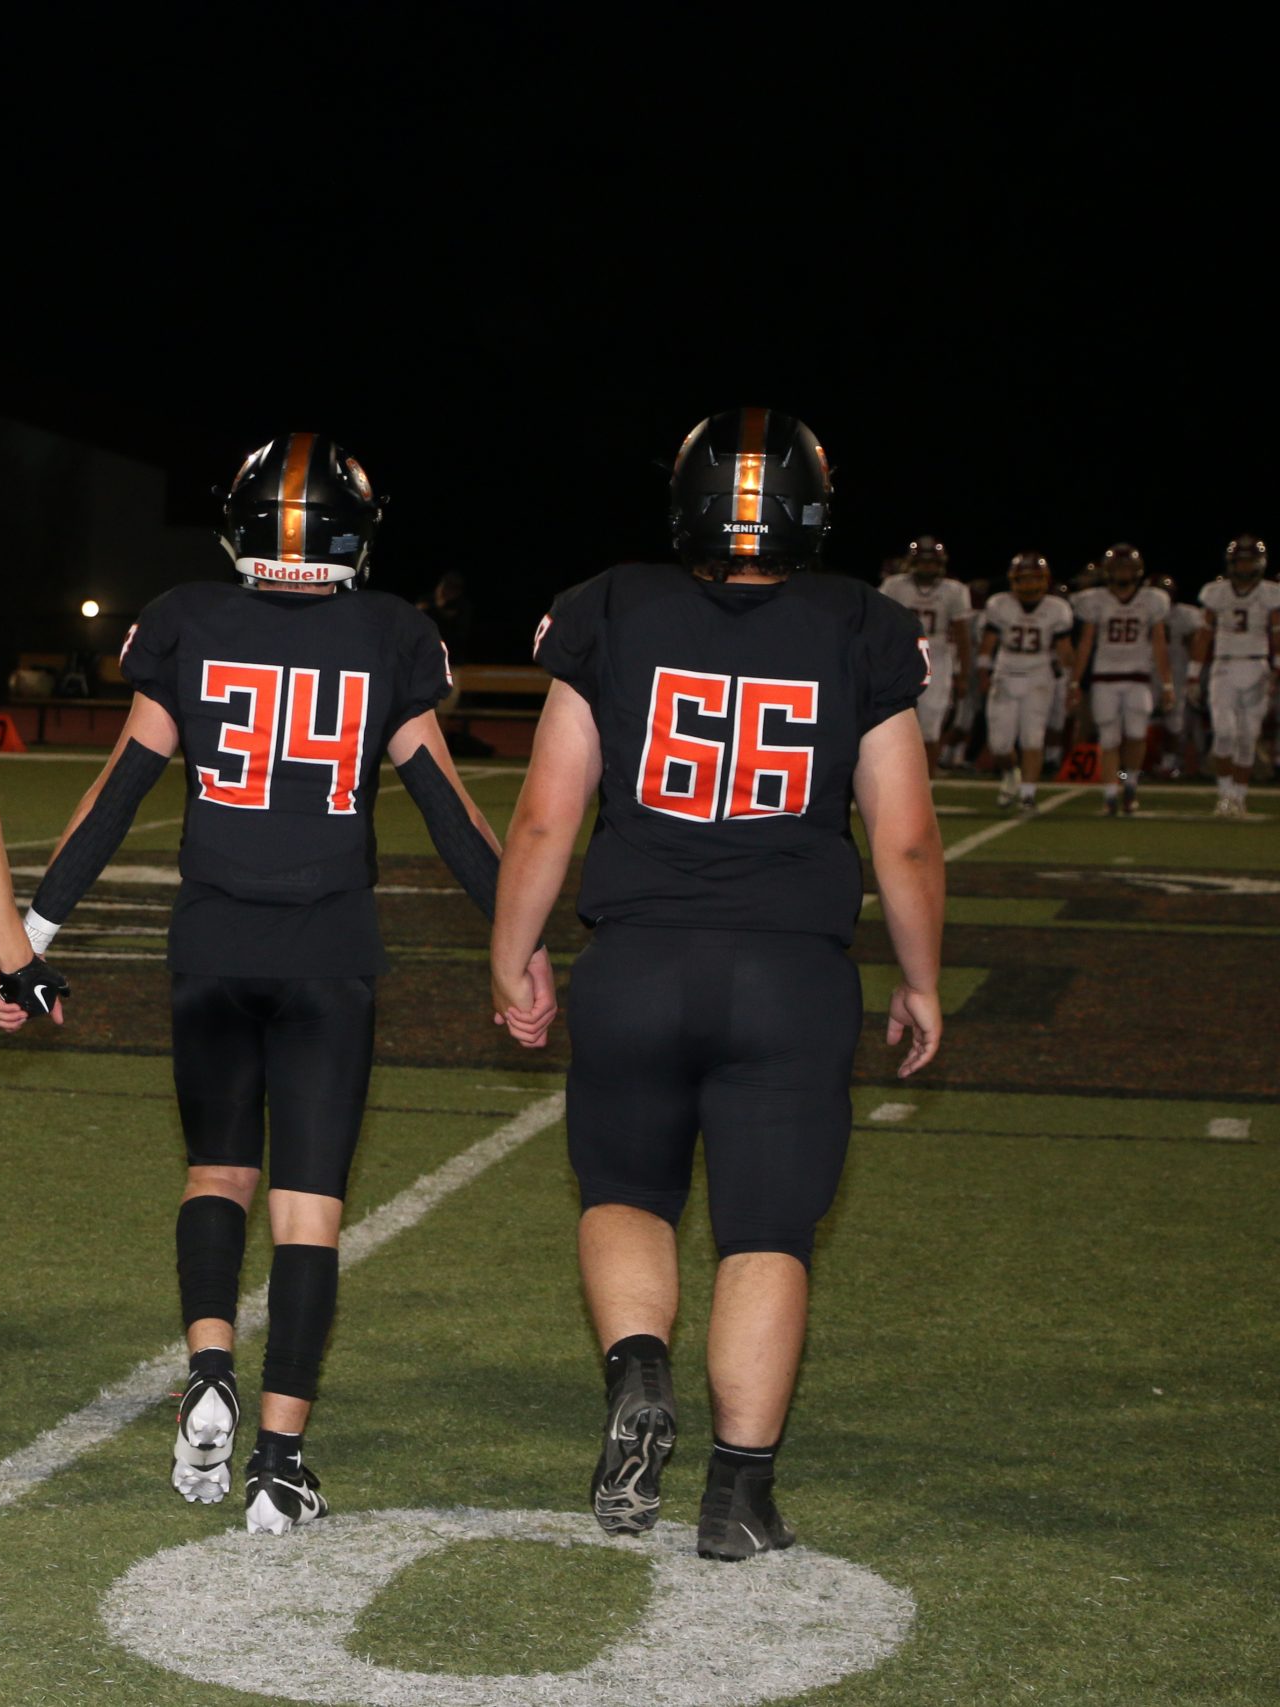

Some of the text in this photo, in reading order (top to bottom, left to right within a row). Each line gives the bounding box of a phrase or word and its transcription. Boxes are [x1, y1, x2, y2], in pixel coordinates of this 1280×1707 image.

[723, 523, 769, 533] XENITH
[254, 562, 329, 580] Riddell
[1108, 618, 1139, 643] 66
[1233, 608, 1248, 633] 3
[1009, 625, 1041, 653] 33
[196, 660, 370, 814] 34
[635, 666, 819, 822] 66
[1071, 751, 1097, 779] 50
